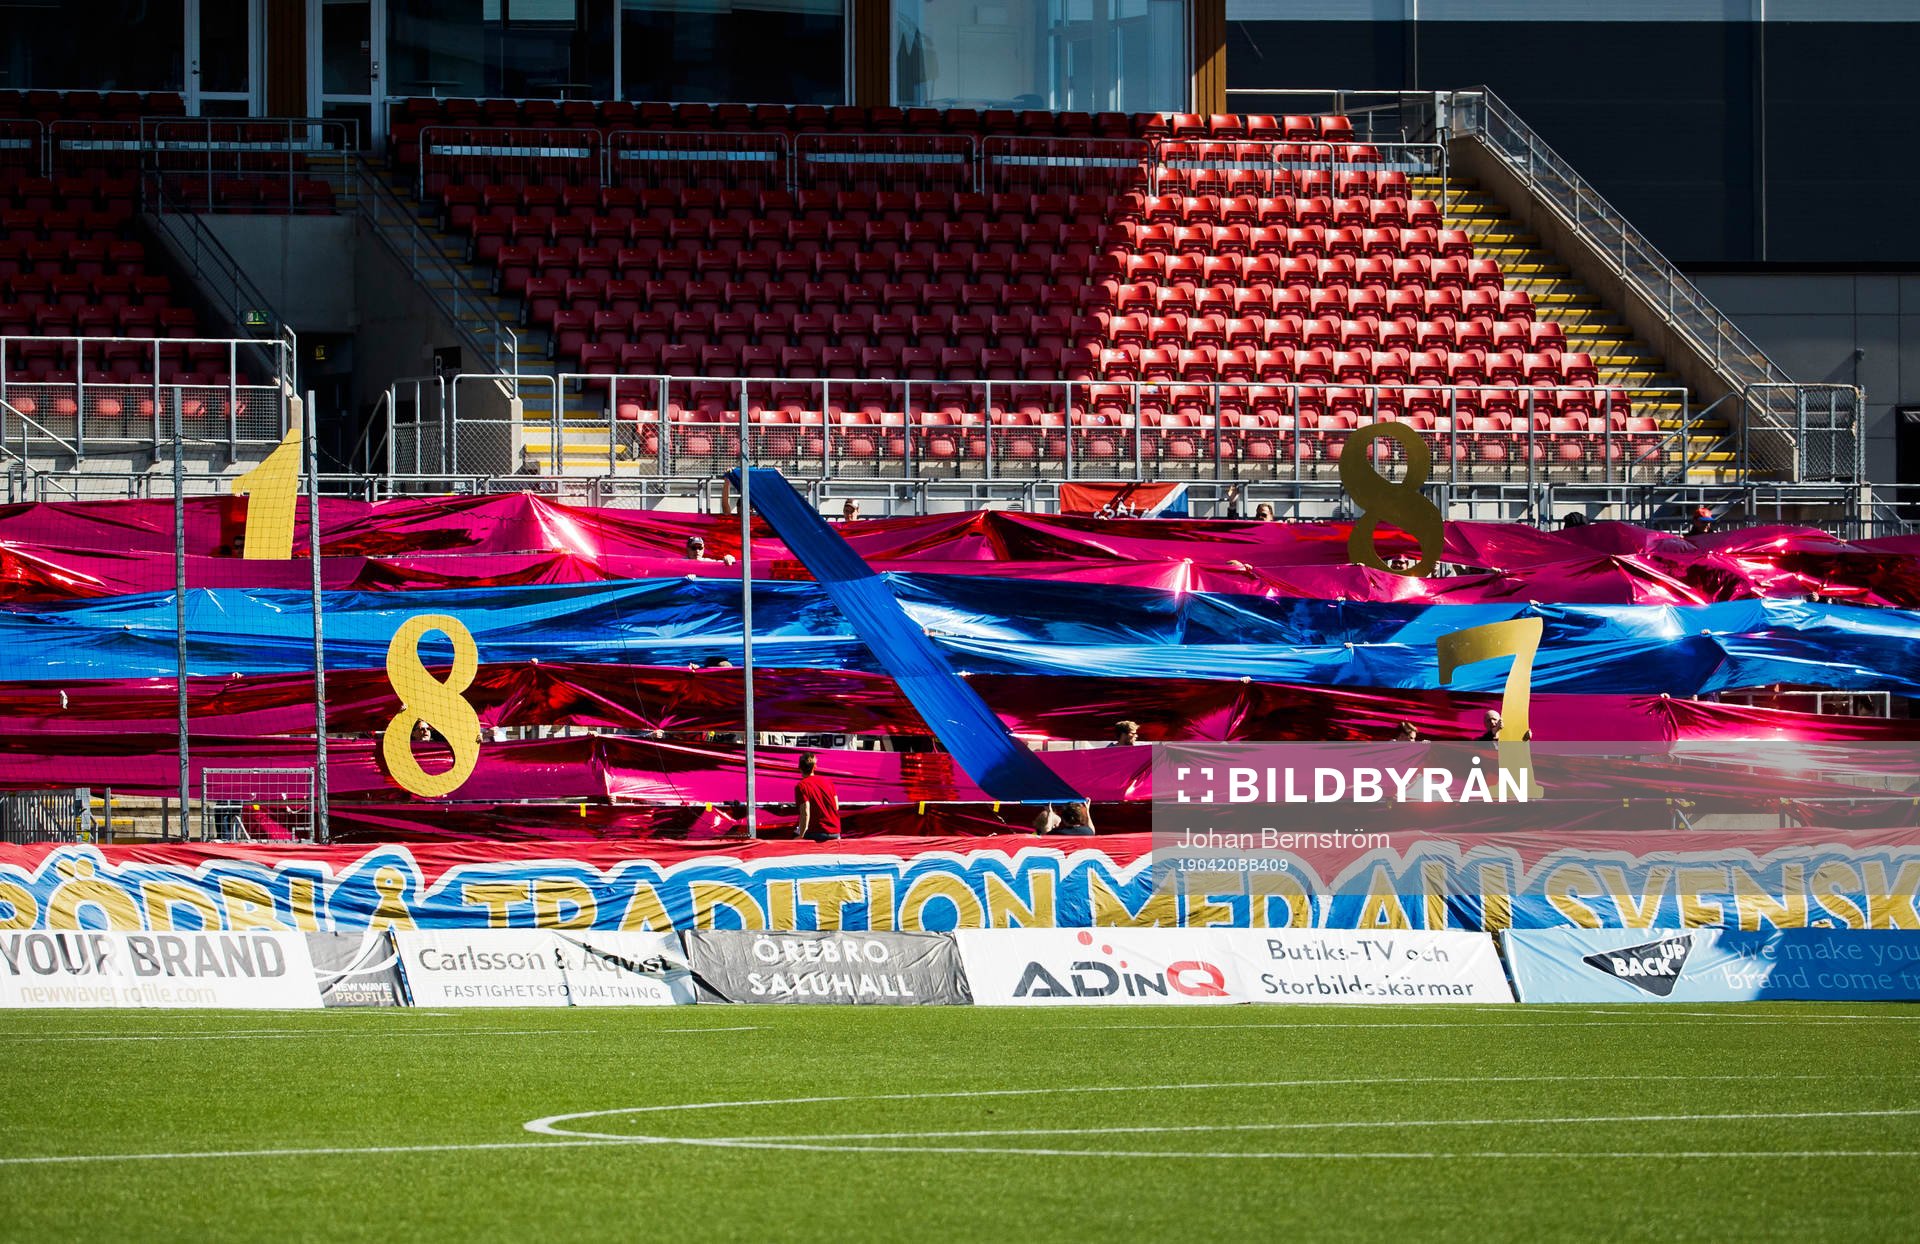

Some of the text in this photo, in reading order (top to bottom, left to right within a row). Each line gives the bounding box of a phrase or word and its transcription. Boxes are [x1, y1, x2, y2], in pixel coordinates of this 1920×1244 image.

[231, 428, 301, 560] 1
[1339, 421, 1444, 578] 8
[383, 614, 480, 797] 8
[0, 933, 287, 978] YOUR BRAND
[418, 945, 545, 971] Carlsson
[752, 934, 889, 963] ÖREBRO
[1266, 938, 1394, 962] Butiks-TV
[1660, 942, 1687, 960] UP
[1729, 940, 1777, 961] We
[1784, 937, 1862, 961] make
[1612, 957, 1677, 978] BACK
[1722, 965, 1810, 990] brand
[1818, 973, 1895, 990] come
[333, 982, 391, 991] NEW WAVE
[335, 991, 394, 1002] PROFILE
[443, 982, 662, 1000] FASTIGHETSFÖVALTNING
[748, 973, 914, 997] SALUHALL
[1260, 973, 1474, 998] Storbildsskärmar
